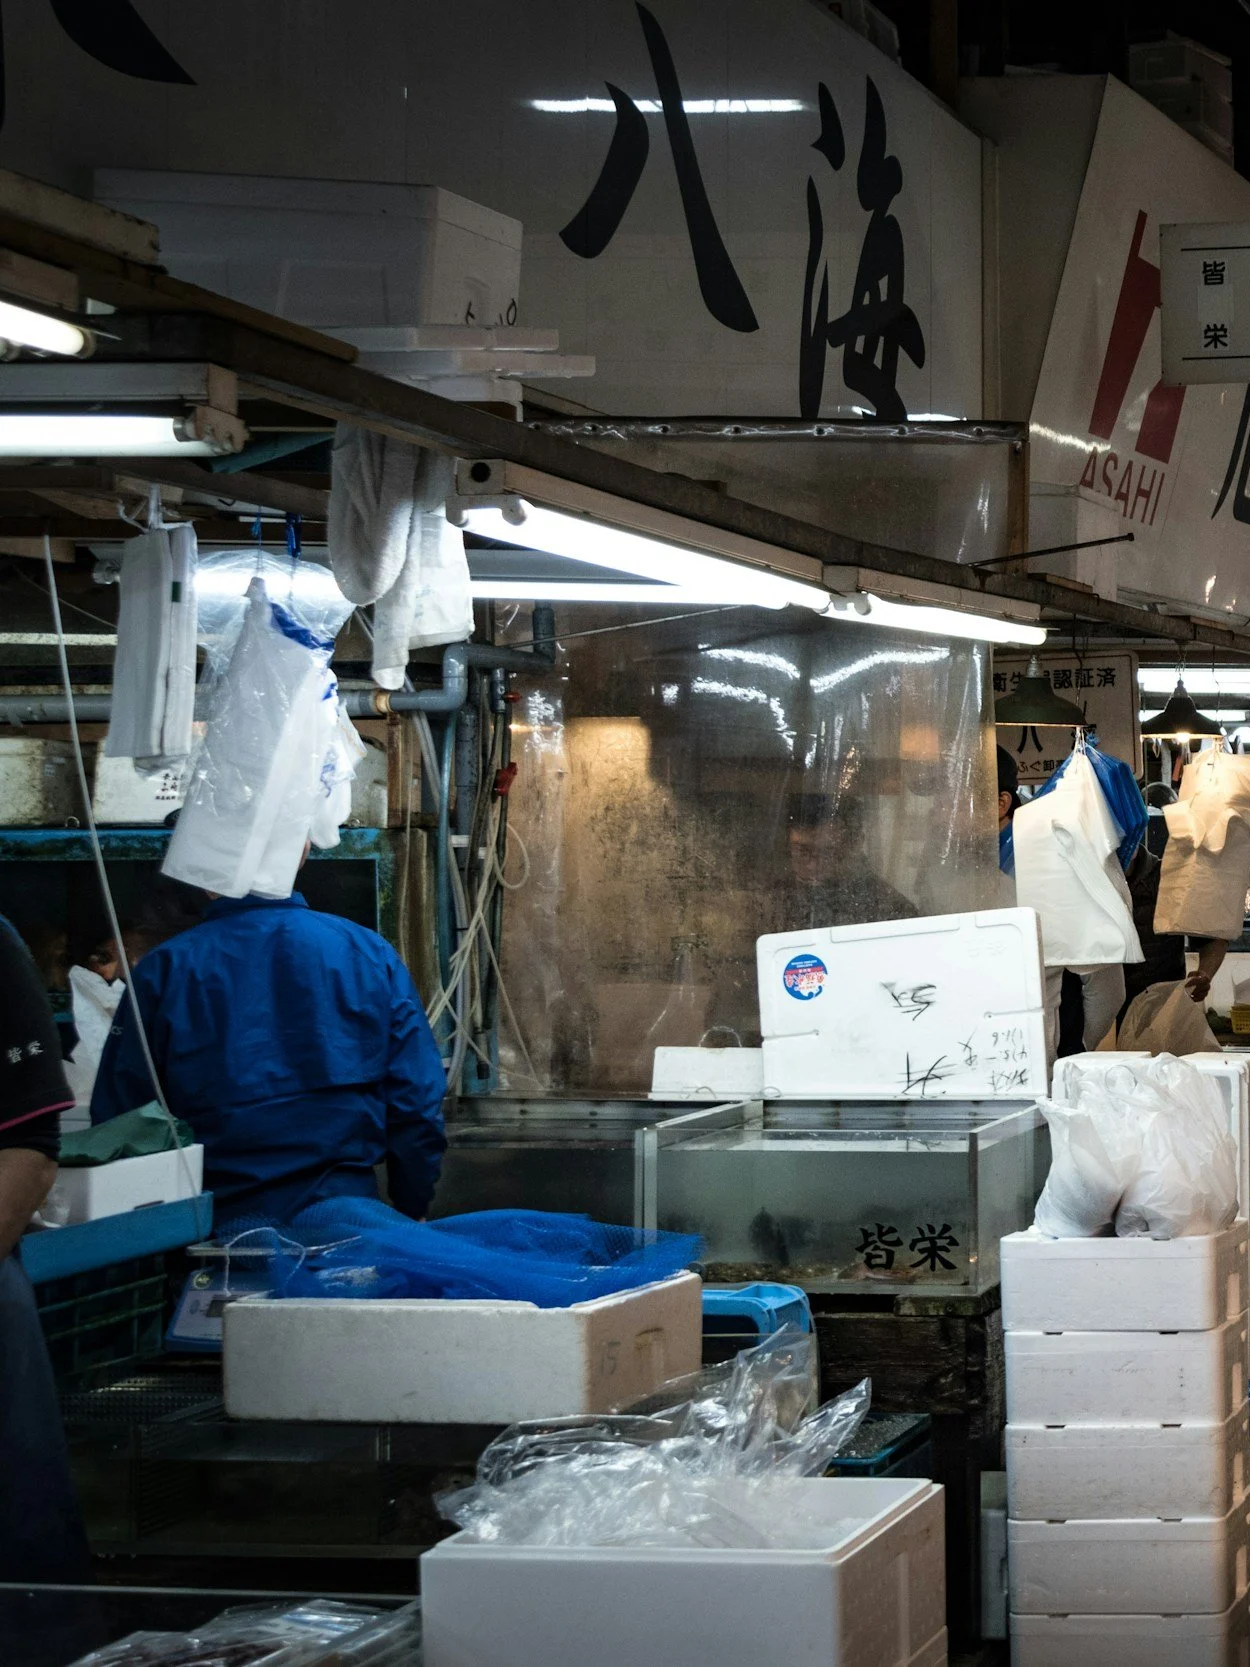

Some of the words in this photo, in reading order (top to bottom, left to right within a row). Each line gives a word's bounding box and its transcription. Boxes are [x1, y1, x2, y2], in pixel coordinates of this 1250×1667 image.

[1202, 260, 1229, 349] 皆栄
[1079, 445, 1165, 526] ASAHI
[993, 666, 1117, 694] 衛認証済
[854, 1222, 960, 1272] 皆栄
